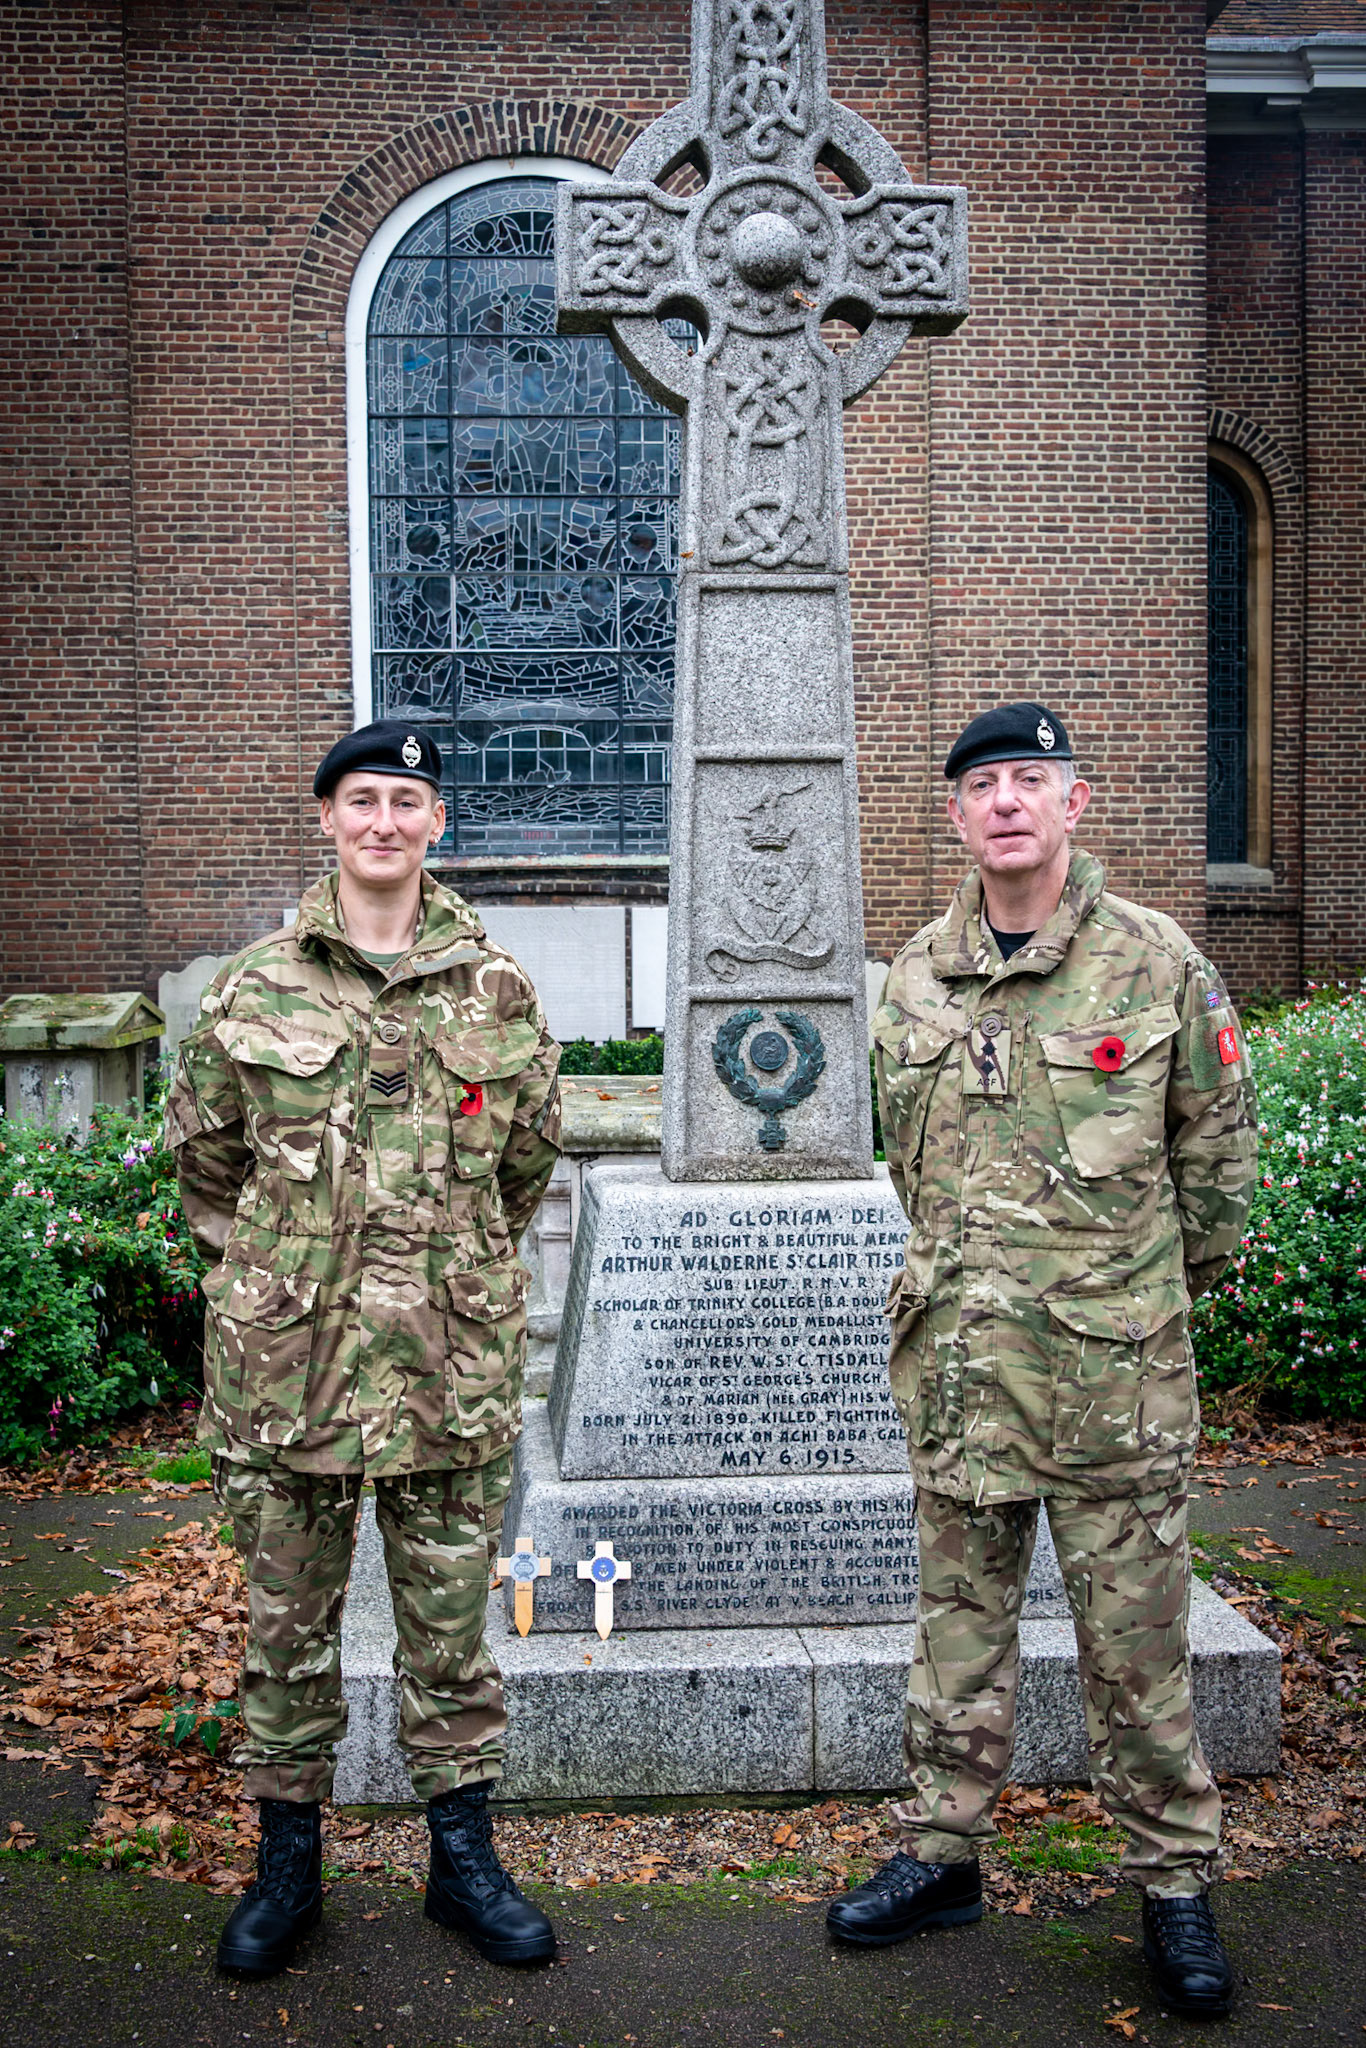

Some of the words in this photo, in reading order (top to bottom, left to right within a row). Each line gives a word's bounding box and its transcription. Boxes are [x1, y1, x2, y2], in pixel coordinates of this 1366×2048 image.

[976, 1078, 997, 1087] ACF
[680, 1211, 708, 1228] AD
[729, 1209, 832, 1227] GLORIAM
[852, 1208, 884, 1225] DEI
[622, 1236, 643, 1250] TO
[650, 1235, 682, 1249] THE
[692, 1234, 750, 1249] BRIGHT
[758, 1234, 769, 1248] &
[776, 1233, 859, 1248] BEAUTIFUL
[601, 1256, 673, 1273] ARTHUR
[681, 1254, 779, 1271] WALDERNE
[806, 1253, 858, 1270] CLAIR
[704, 1278, 734, 1292] SUB
[594, 1299, 659, 1312] SCHOLAR
[664, 1299, 682, 1311] OF
[688, 1298, 745, 1311] TRINITY
[751, 1296, 815, 1309] COLLEGE
[633, 1319, 643, 1331] &
[762, 1317, 798, 1329] GOLD
[805, 1315, 884, 1328] MEDALLIST
[674, 1336, 772, 1349] UNIVERSITY
[781, 1335, 800, 1347] OF
[644, 1358, 674, 1370] SON
[684, 1358, 702, 1370] OF
[816, 1352, 887, 1367] TISDALL
[650, 1376, 692, 1388] VICAR
[699, 1375, 719, 1387] OF
[743, 1371, 814, 1387] GEORGE'S
[661, 1395, 672, 1406] &
[677, 1395, 694, 1406] OF
[703, 1393, 759, 1406] MARIAN
[850, 1391, 873, 1404] HIS
[583, 1414, 625, 1428] BORN
[633, 1413, 673, 1427] JULY
[762, 1411, 816, 1424] KILLED
[623, 1434, 639, 1446] IN
[646, 1433, 677, 1446] THE
[684, 1431, 744, 1446] ATTACK
[752, 1430, 773, 1443] ON
[780, 1430, 817, 1443] ACHI
[720, 1450, 766, 1467] MAY
[807, 1448, 855, 1468] 1915
[562, 1504, 639, 1521] AWARDED
[649, 1504, 678, 1518] THE
[688, 1501, 763, 1517] VICTORIA
[773, 1500, 824, 1515] CROSS
[834, 1500, 855, 1514] BY
[862, 1499, 888, 1513] HIS
[576, 1527, 589, 1539] IN
[705, 1523, 723, 1535] OF
[735, 1521, 759, 1535] HIS
[770, 1520, 810, 1534] MOST
[687, 1542, 704, 1554] TO
[714, 1540, 754, 1554] DUTY
[765, 1539, 781, 1552] IN
[872, 1536, 916, 1550] MANY
[654, 1561, 692, 1574] MEN
[697, 1559, 744, 1573] UNDER
[755, 1557, 819, 1571] VIOLENT
[826, 1557, 835, 1570] &
[845, 1555, 919, 1569] ACCURATE
[639, 1580, 665, 1592] THE
[677, 1577, 739, 1591] LANDING
[750, 1577, 768, 1590] OF
[781, 1576, 809, 1589] THE
[821, 1574, 882, 1588] BRITISH
[537, 1601, 578, 1614] FROM
